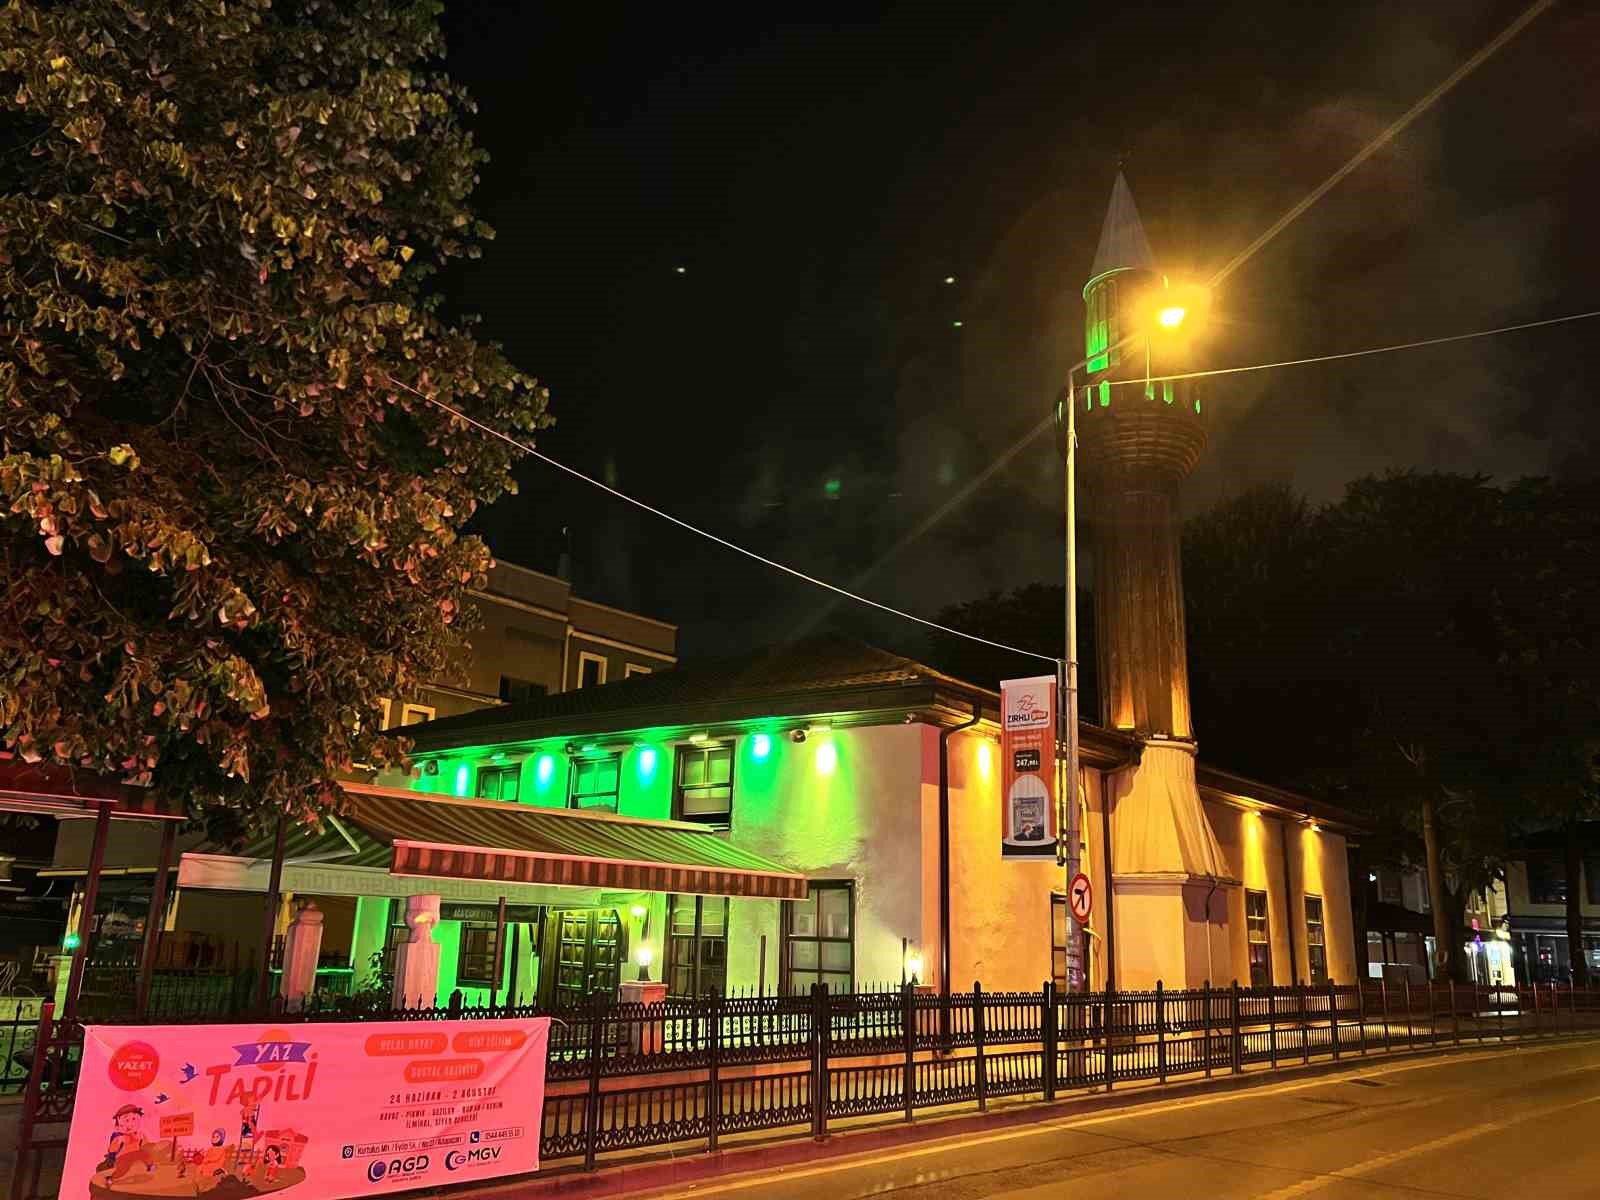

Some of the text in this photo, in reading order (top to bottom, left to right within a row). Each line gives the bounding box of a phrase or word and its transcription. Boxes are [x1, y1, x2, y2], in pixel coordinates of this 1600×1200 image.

[254, 1043, 293, 1062] YAZ
[467, 1146, 502, 1161] MGV
[388, 1154, 429, 1174] AGD
